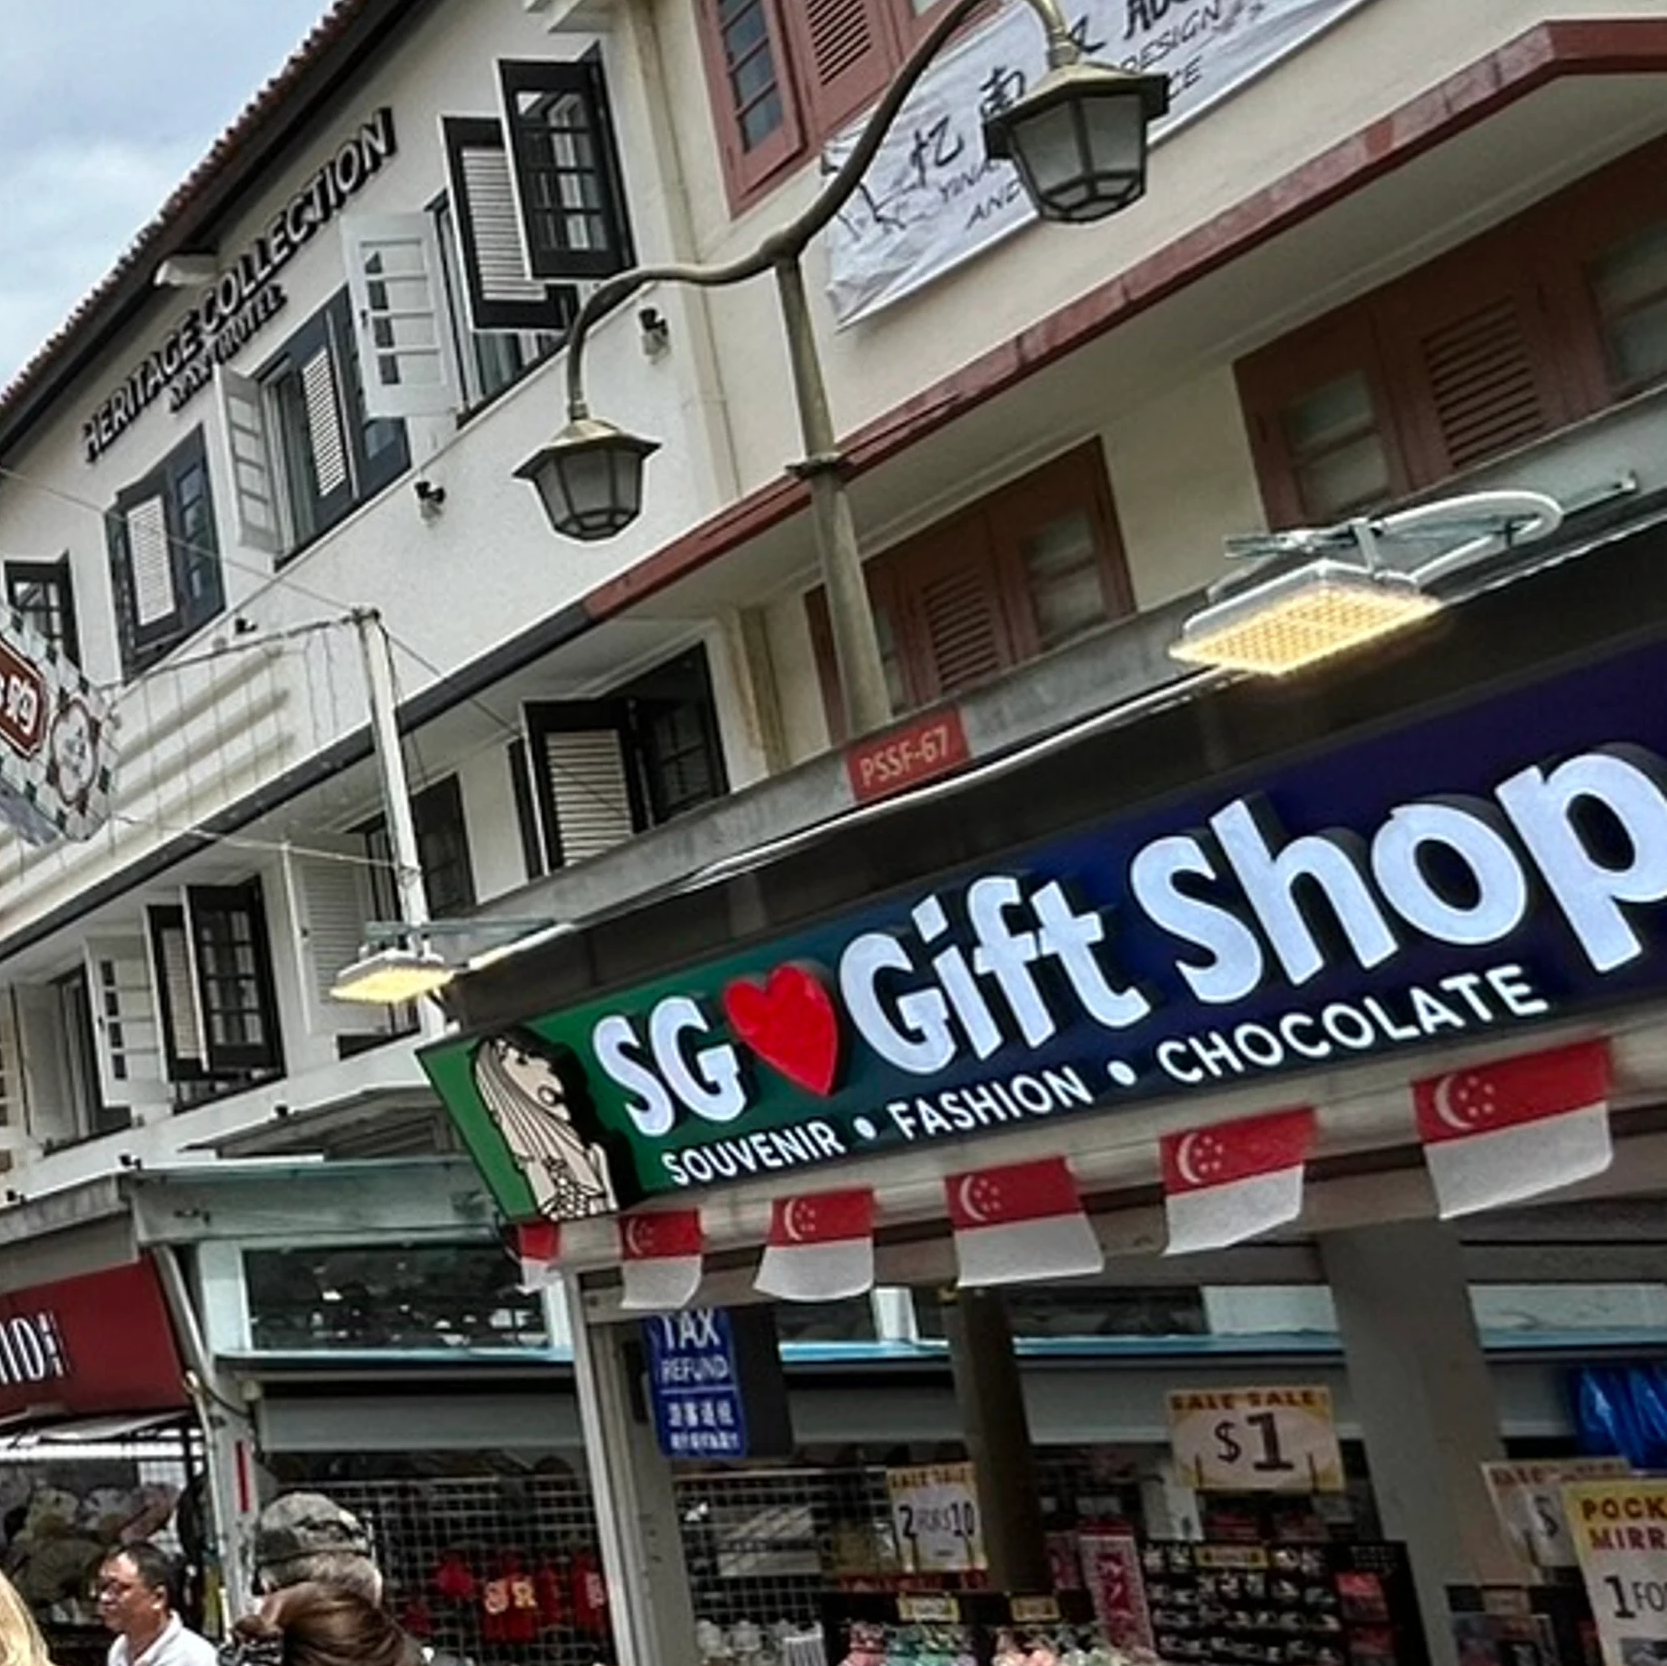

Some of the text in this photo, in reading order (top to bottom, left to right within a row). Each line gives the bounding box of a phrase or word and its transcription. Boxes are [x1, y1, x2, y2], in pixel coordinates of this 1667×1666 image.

[82, 107, 399, 464] HERITAGE COLLECTION
[859, 725, 948, 787] PSSF-67
[593, 753, 1667, 1136] SG Gift Shop
[662, 964, 1550, 1187] SOUVENIR FASHION CHOCOLATE
[661, 1354, 729, 1382] REFUND
[1171, 1390, 1316, 1411] SALE SALE
[1214, 1411, 1295, 1472] $1
[899, 1504, 916, 1540] 2
